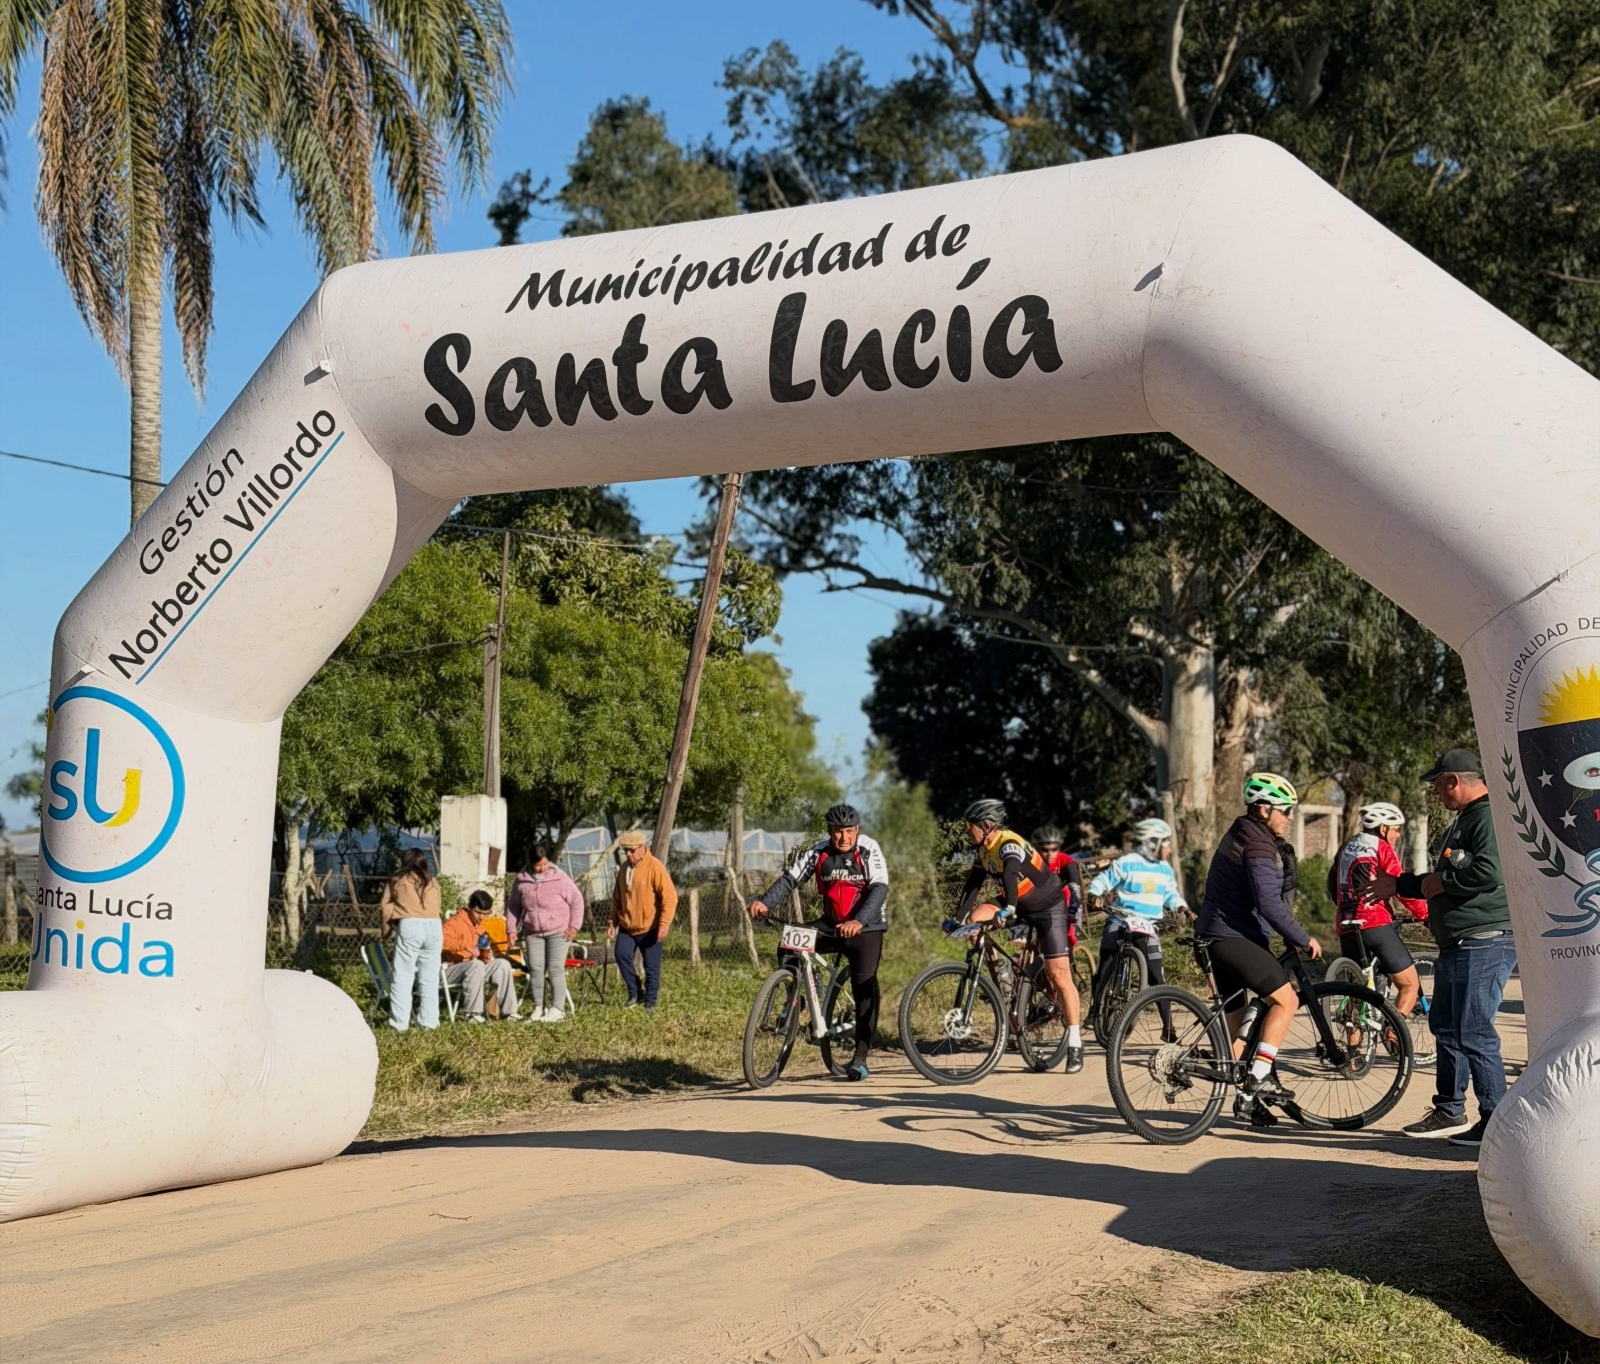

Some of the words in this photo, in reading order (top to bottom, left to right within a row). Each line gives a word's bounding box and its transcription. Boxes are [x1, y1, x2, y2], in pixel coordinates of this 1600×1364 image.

[505, 222, 894, 314] Municipalidad
[905, 214, 971, 263] de
[423, 312, 734, 437] Santa
[768, 257, 1064, 404] Lucía
[107, 537, 233, 680] Norberto
[222, 409, 336, 533] Villordo
[138, 446, 245, 575] Gestión
[1504, 622, 1568, 724] MUNICIPALIDAD
[36, 883, 77, 911] anta
[88, 889, 173, 920] Lucía
[784, 931, 811, 948] 102
